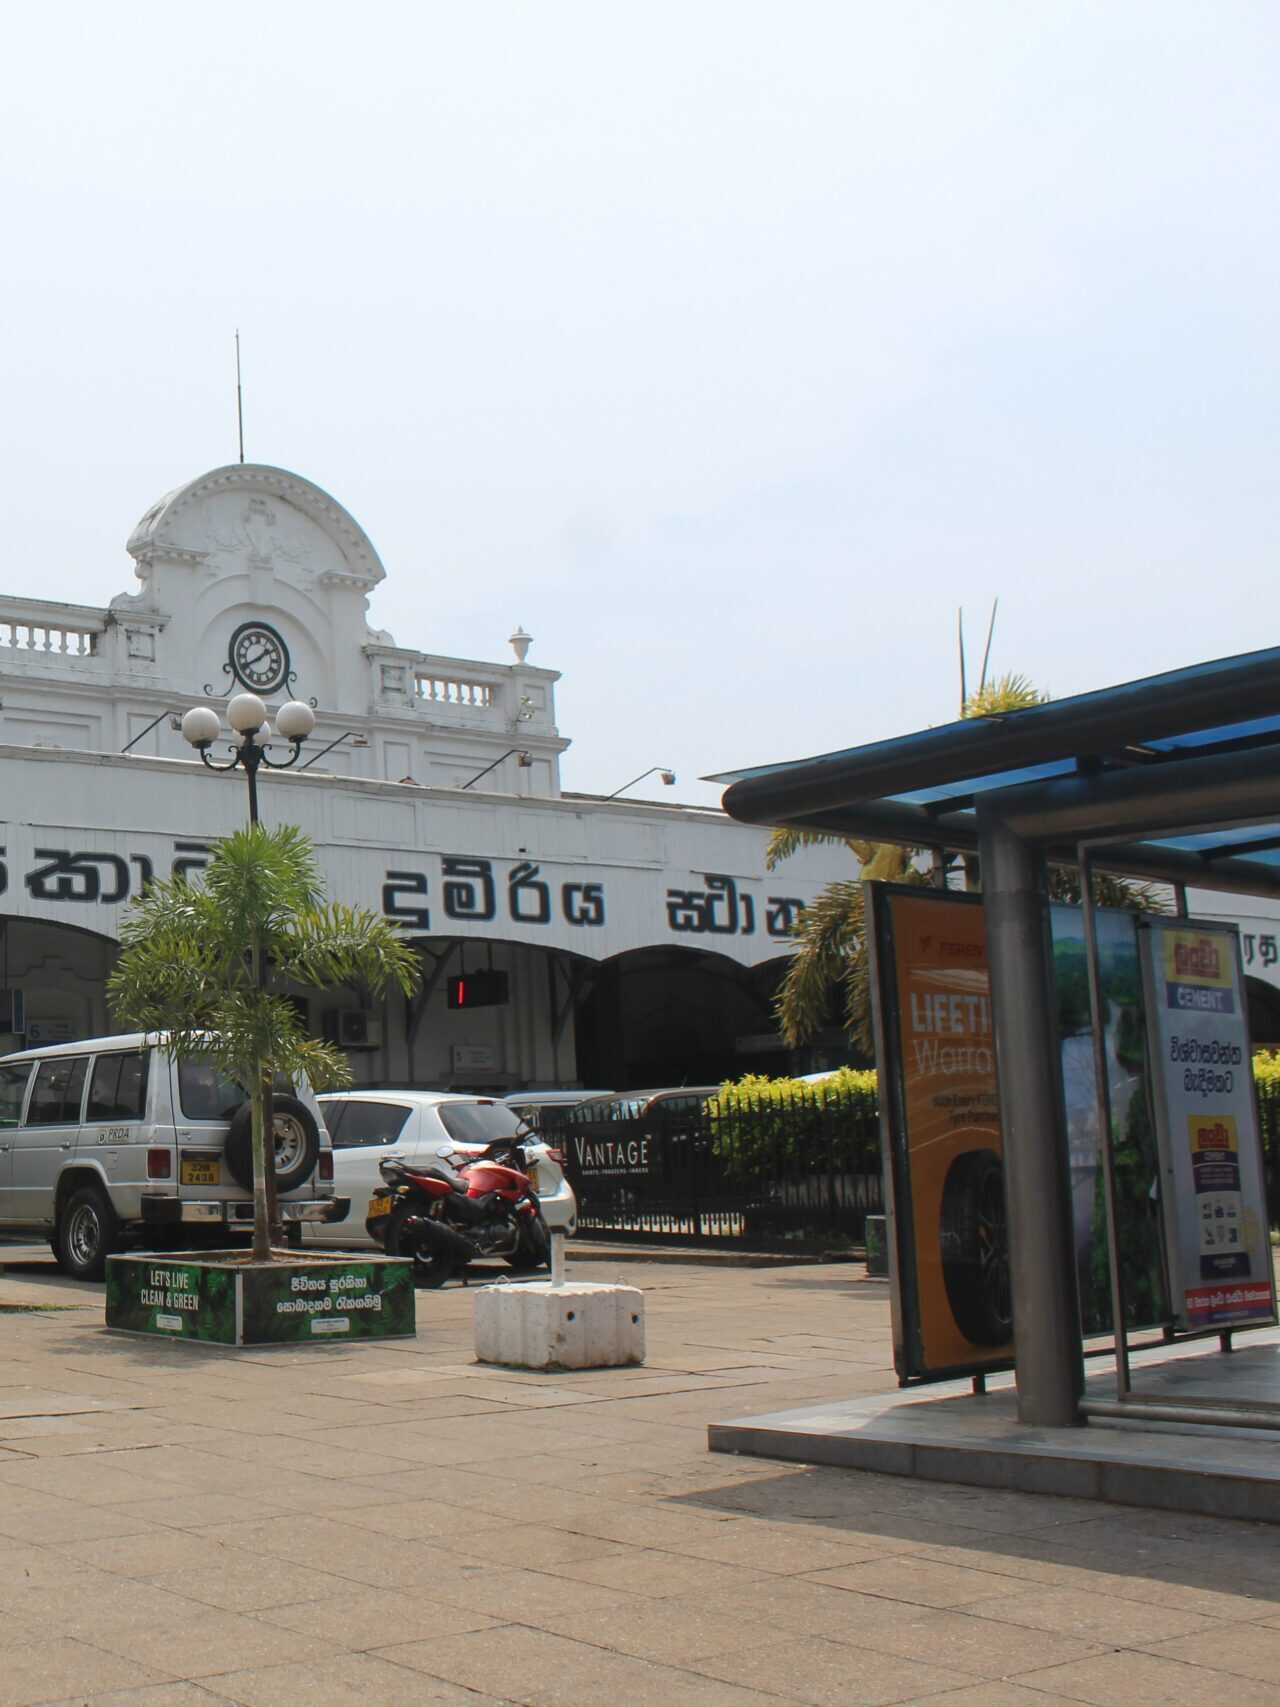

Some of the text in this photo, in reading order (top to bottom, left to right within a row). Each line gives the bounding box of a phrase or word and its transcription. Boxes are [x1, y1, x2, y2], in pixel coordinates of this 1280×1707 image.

[1177, 985, 1224, 1010] CEMENT
[910, 992, 991, 1033] LIFETI
[912, 1039, 993, 1073] Warra
[151, 1270, 189, 1289] LET'S LIVE
[141, 1289, 199, 1310] CLEAN & GREEN
